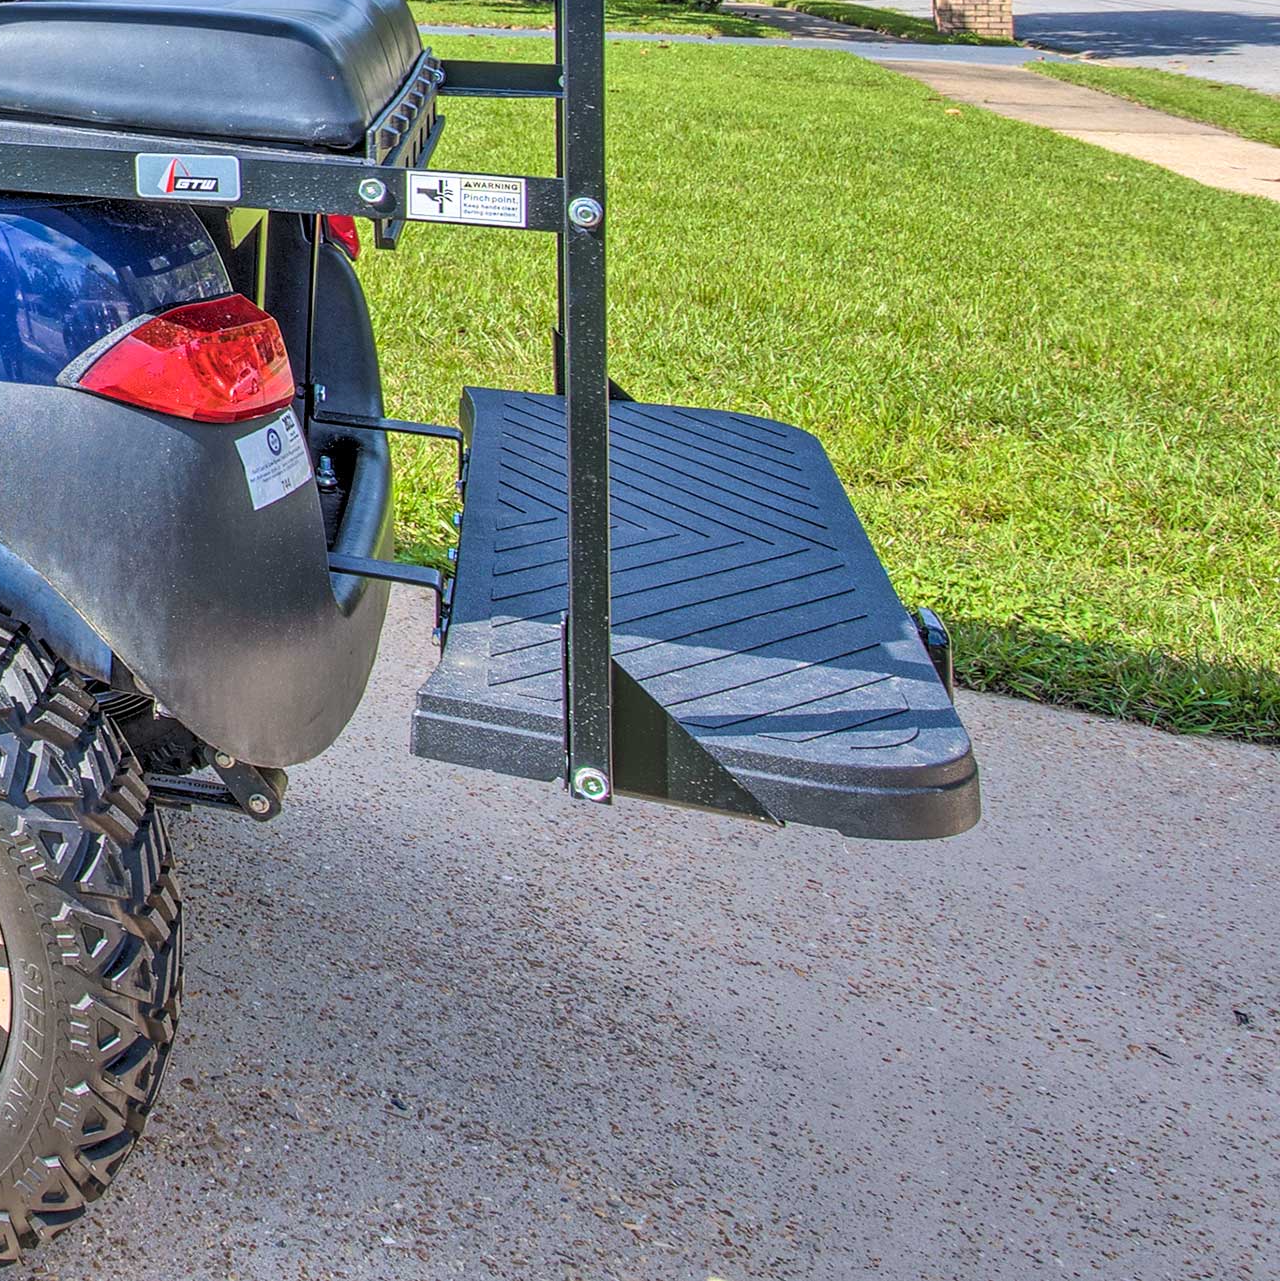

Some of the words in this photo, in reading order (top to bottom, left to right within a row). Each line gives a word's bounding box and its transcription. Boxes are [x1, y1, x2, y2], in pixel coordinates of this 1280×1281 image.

[175, 178, 217, 190] GTW
[473, 182, 518, 191] WARNING
[463, 193, 491, 202] Pinch
